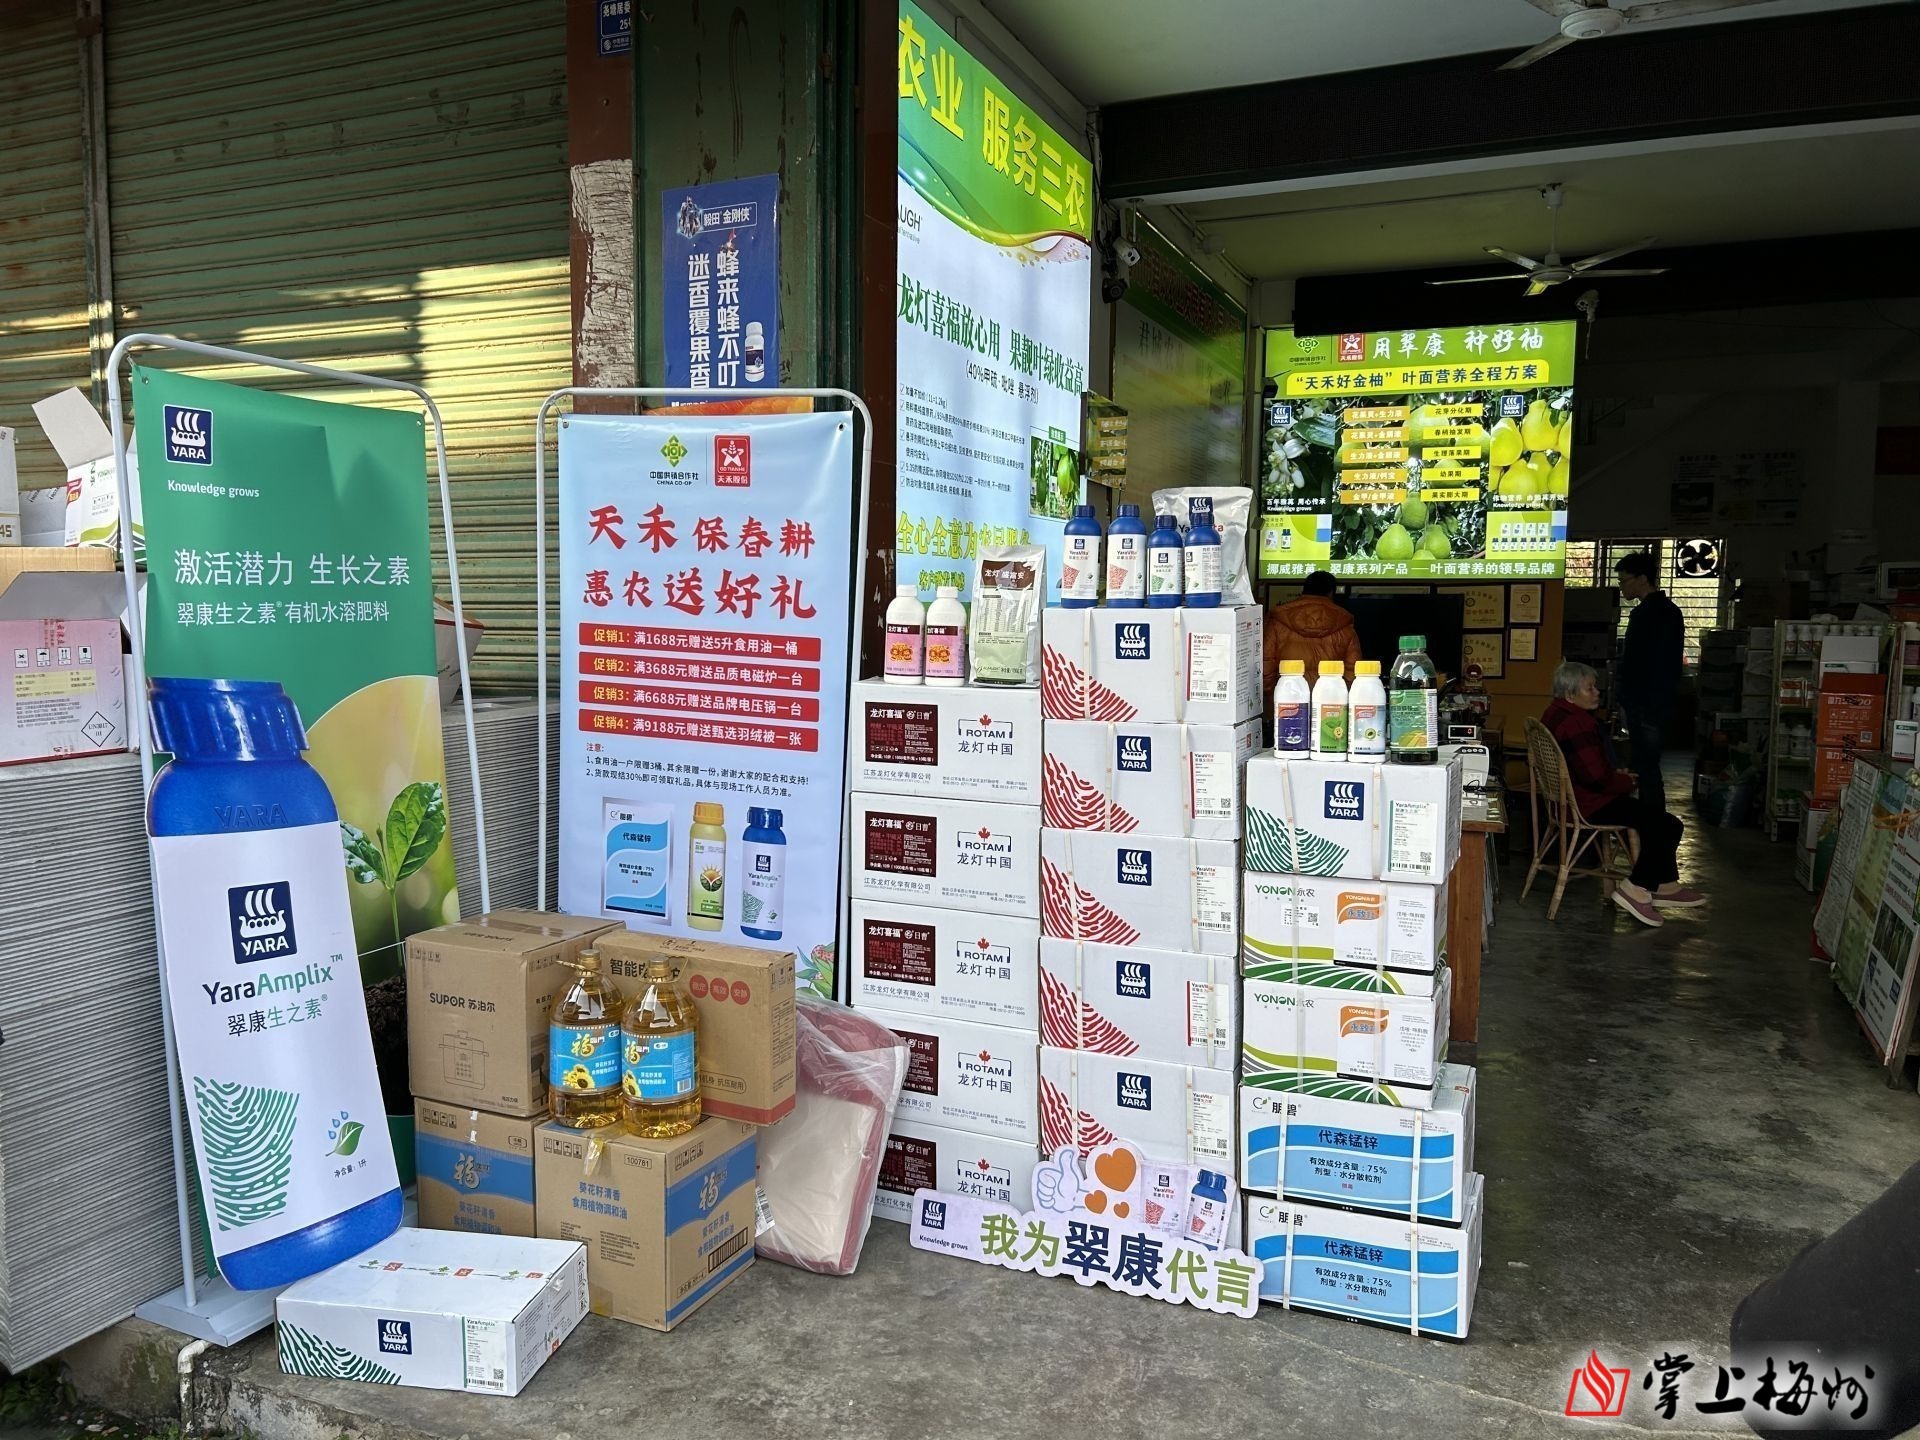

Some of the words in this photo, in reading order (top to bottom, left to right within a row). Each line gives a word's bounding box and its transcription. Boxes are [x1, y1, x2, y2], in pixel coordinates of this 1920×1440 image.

[982, 86, 1085, 230] 服务三农
[898, 203, 921, 231] UGH
[687, 253, 711, 388] 迷香覆果香
[716, 249, 741, 387] 蜂来蜂不叮
[898, 273, 1000, 361] 龙灯喜福放心用
[1372, 333, 1446, 360] 用翠康
[1402, 364, 1538, 385] 叶面营养全程方案
[171, 445, 206, 460] YARA
[717, 475, 748, 485] 天禾股份
[168, 480, 226, 497] Knowledge
[228, 486, 260, 498] grows
[174, 548, 293, 586] 激活潜力
[309, 552, 410, 586] 生长之素
[583, 567, 817, 620] 惠农送好礼
[1119, 649, 1146, 657] YARA
[966, 729, 1006, 739] ROTAM
[958, 741, 1013, 756] 龙灯中国
[1121, 760, 1147, 769] YARA
[863, 768, 932, 780] 江苏龙灯化学有限公司
[1328, 808, 1359, 817] YARA
[965, 841, 1005, 852] ROTAM
[957, 853, 1011, 869] 龙灯中国
[864, 877, 931, 891] 江苏龙灯化学有限公司
[1122, 873, 1148, 883] YARA
[241, 935, 289, 956] YARA
[964, 951, 1003, 963] ROTAM
[956, 962, 1010, 980] 龙灯中国
[863, 983, 930, 999] 江苏龙灯化学有限公司
[1120, 985, 1147, 996] YARA
[429, 992, 465, 1008] SUPOR
[467, 998, 496, 1013] 苏泊尔
[966, 1062, 1005, 1076] ROTAM
[958, 1073, 1012, 1093] 龙灯中国
[1121, 1096, 1147, 1107] YARA
[1318, 1129, 1379, 1150] 代森锰锌
[626, 1156, 650, 1168] 100781
[965, 1170, 1003, 1185] ROTAM
[579, 1181, 621, 1202] 葵花籽清香
[957, 1180, 1010, 1202] 龙灯中国
[571, 1197, 628, 1221] 食用植物调和油
[924, 1219, 942, 1228] YARA
[919, 1234, 950, 1248] Knowledge
[950, 1241, 968, 1250] grows
[1325, 1239, 1383, 1263] 代森锰锌
[980, 1213, 1256, 1308] 我为翠康代言
[383, 1342, 409, 1352] YARA
